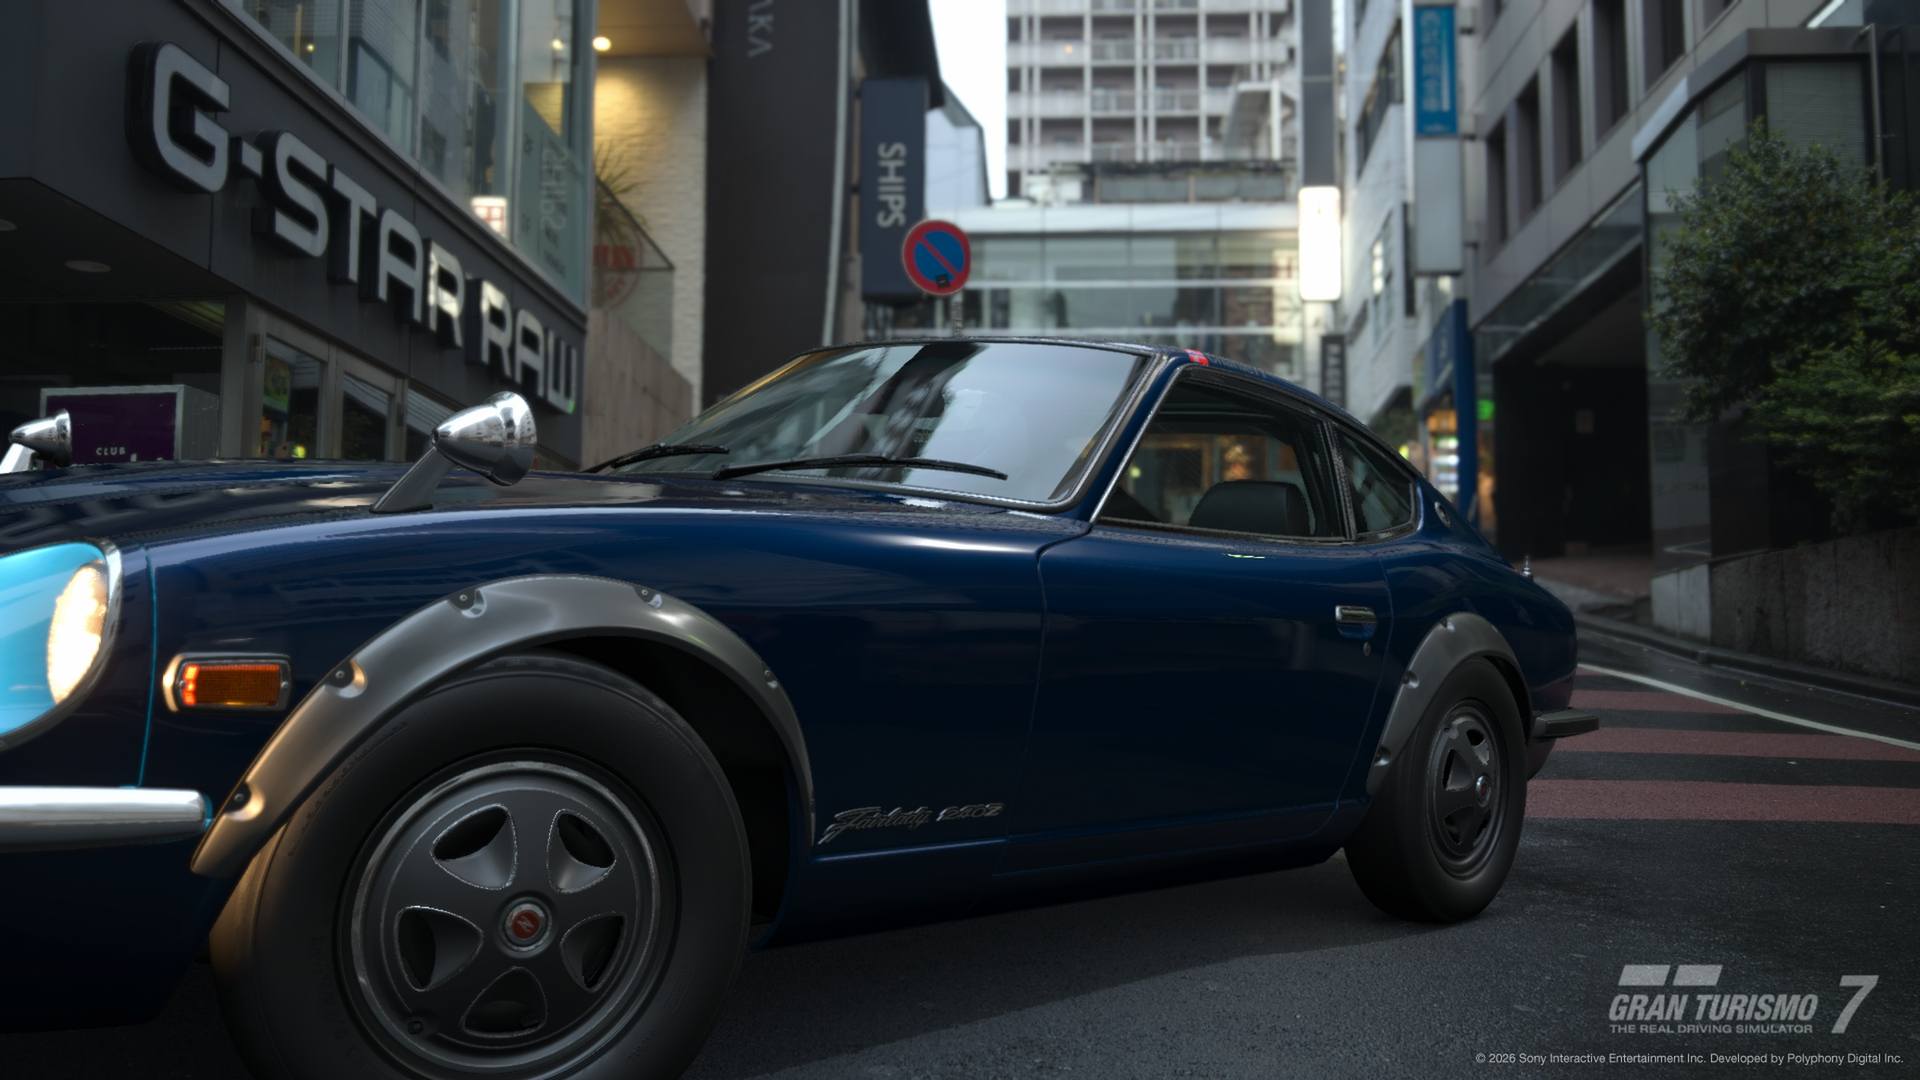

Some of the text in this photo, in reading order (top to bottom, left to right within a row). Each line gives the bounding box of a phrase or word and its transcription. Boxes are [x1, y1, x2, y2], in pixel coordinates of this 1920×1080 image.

[876, 142, 908, 230] SHIPS
[142, 41, 580, 416] G-STAR RAW
[95, 446, 126, 457] CLUB
[817, 804, 934, 846] Fairlady
